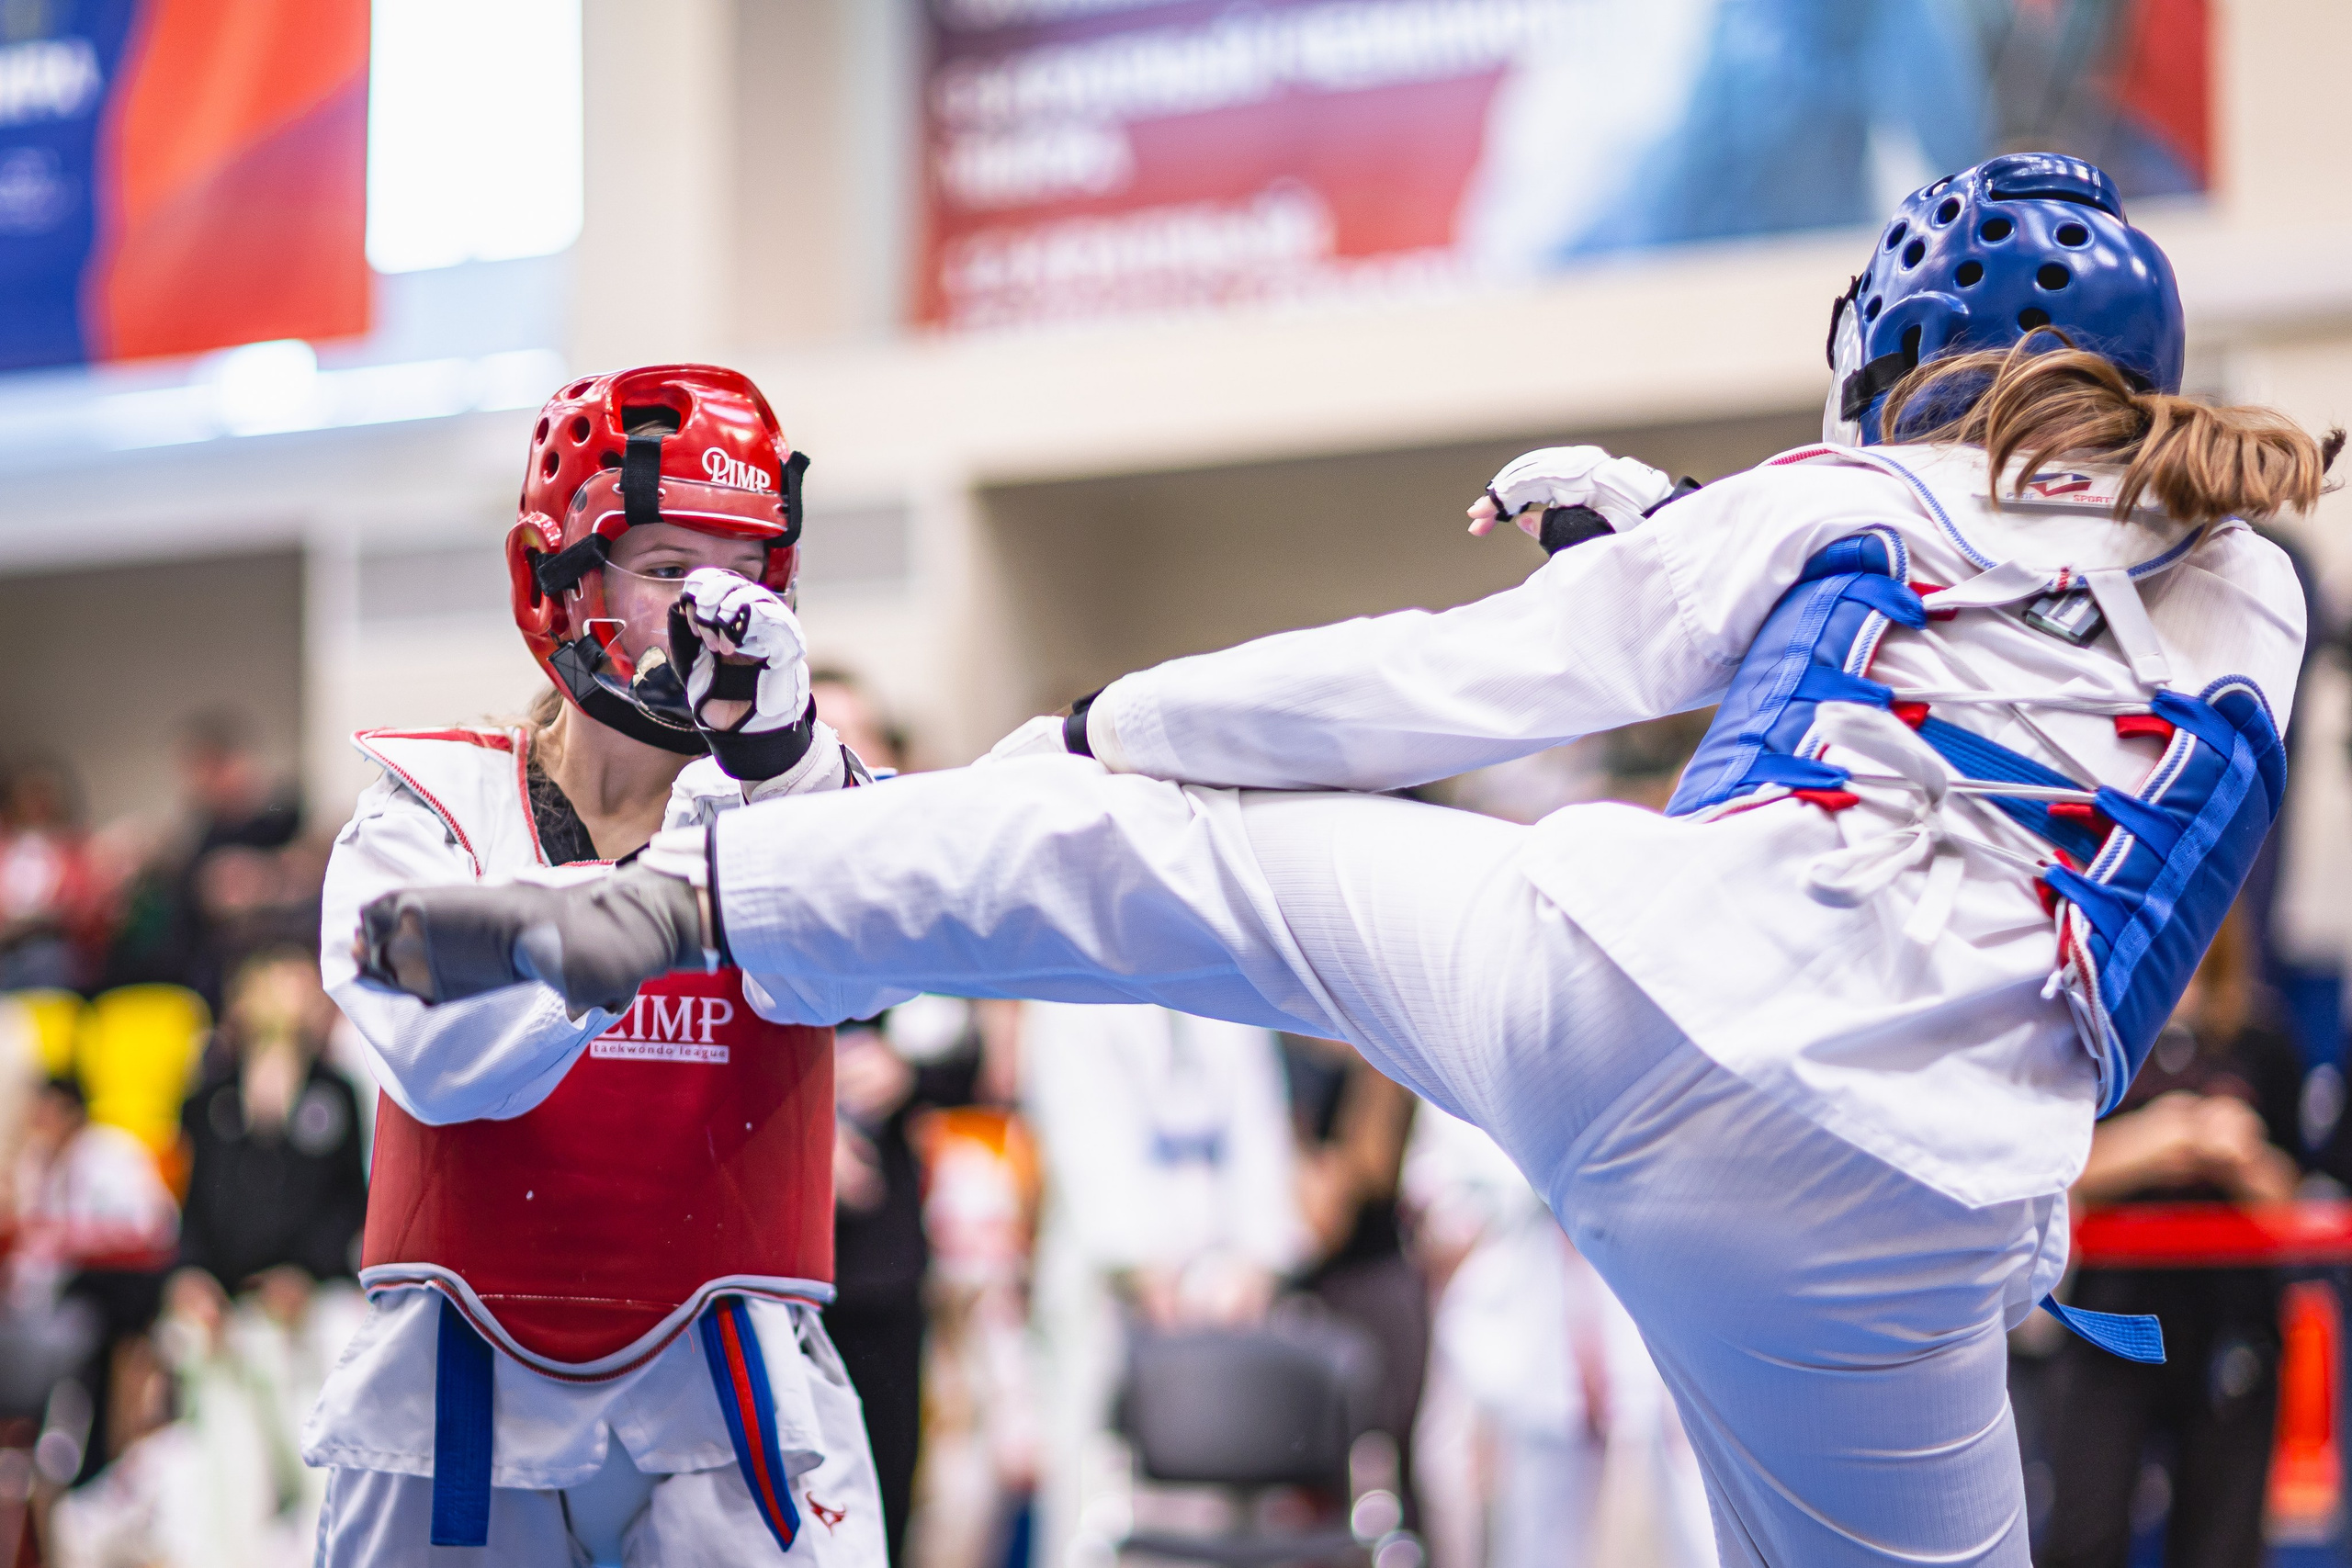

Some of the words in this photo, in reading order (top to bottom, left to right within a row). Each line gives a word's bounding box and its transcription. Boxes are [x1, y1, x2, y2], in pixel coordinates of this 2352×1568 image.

[701, 446, 772, 492] OLIMP
[2006, 491, 2035, 500] POF
[594, 1043, 673, 1055] taekwondo
[679, 1045, 727, 1059] league
